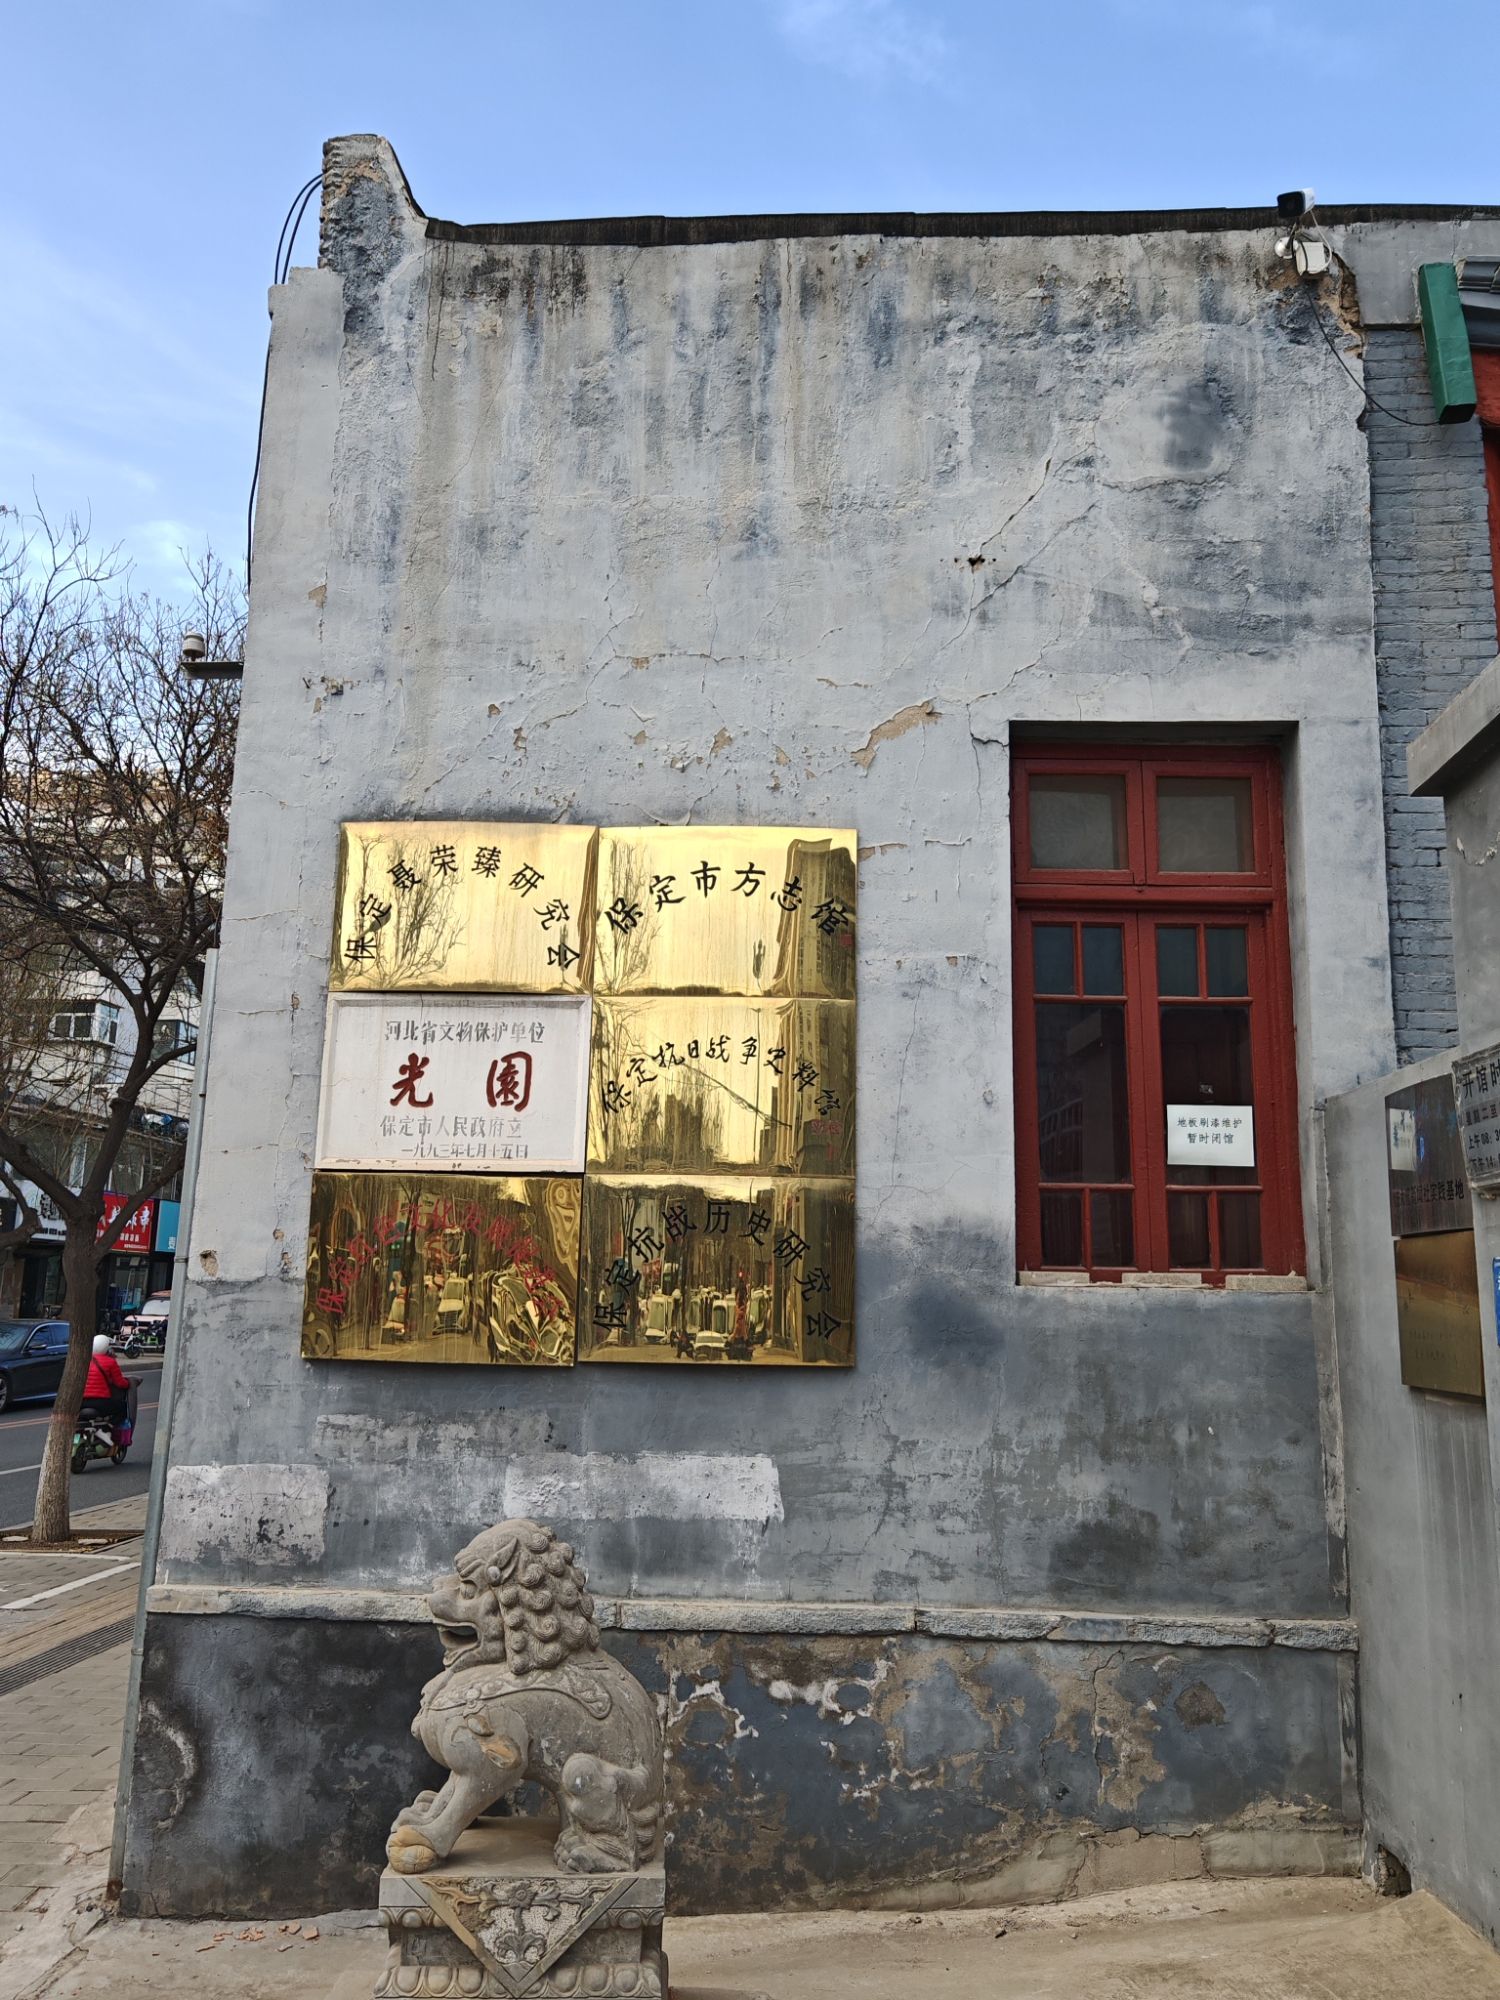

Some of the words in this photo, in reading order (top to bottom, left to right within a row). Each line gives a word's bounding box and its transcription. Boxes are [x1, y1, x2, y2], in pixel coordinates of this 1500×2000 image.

[344, 844, 581, 970] 保定聂荣臻研究会
[604, 860, 849, 936] 保定市方志馆
[384, 1020, 546, 1044] 河北省文物保护单位
[602, 1034, 842, 1116] 保定抗日战争史料馆
[380, 1115, 522, 1138] 保定市人民政府立
[1177, 1117, 1242, 1128] 地板刷漆维护
[1187, 1132, 1234, 1144] 暂时闭馆
[401, 1142, 529, 1160] 一九九三年七月十五日
[593, 1200, 842, 1340] 保定抗战历史研究会
